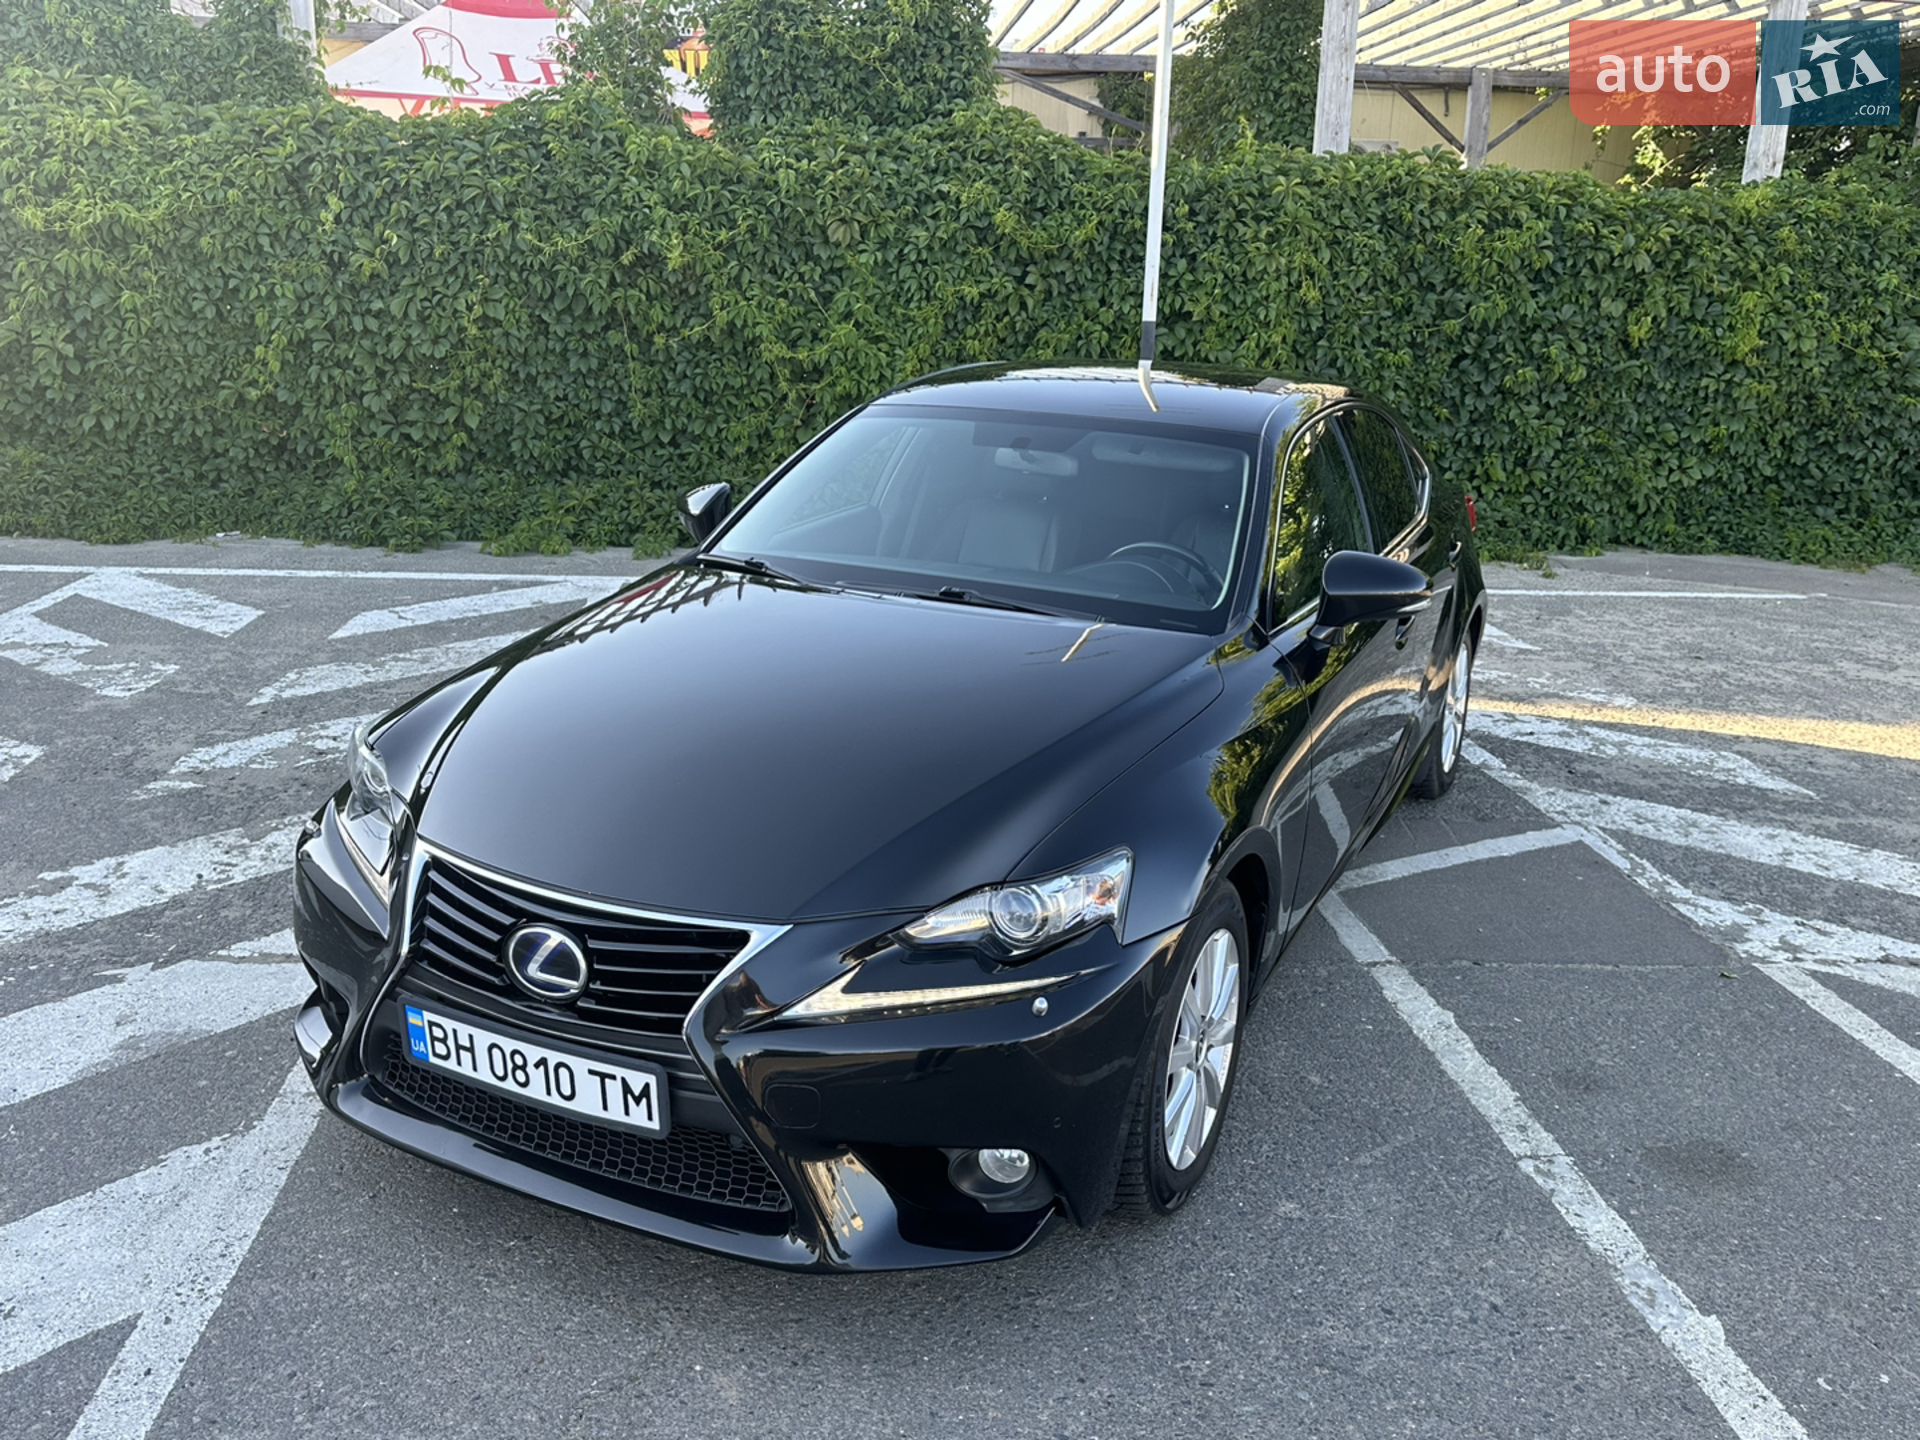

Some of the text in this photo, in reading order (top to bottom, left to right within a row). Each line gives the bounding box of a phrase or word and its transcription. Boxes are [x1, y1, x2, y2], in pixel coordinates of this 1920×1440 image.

[411, 1037, 427, 1055] UA
[427, 1020, 654, 1123] BH 0810 TM
